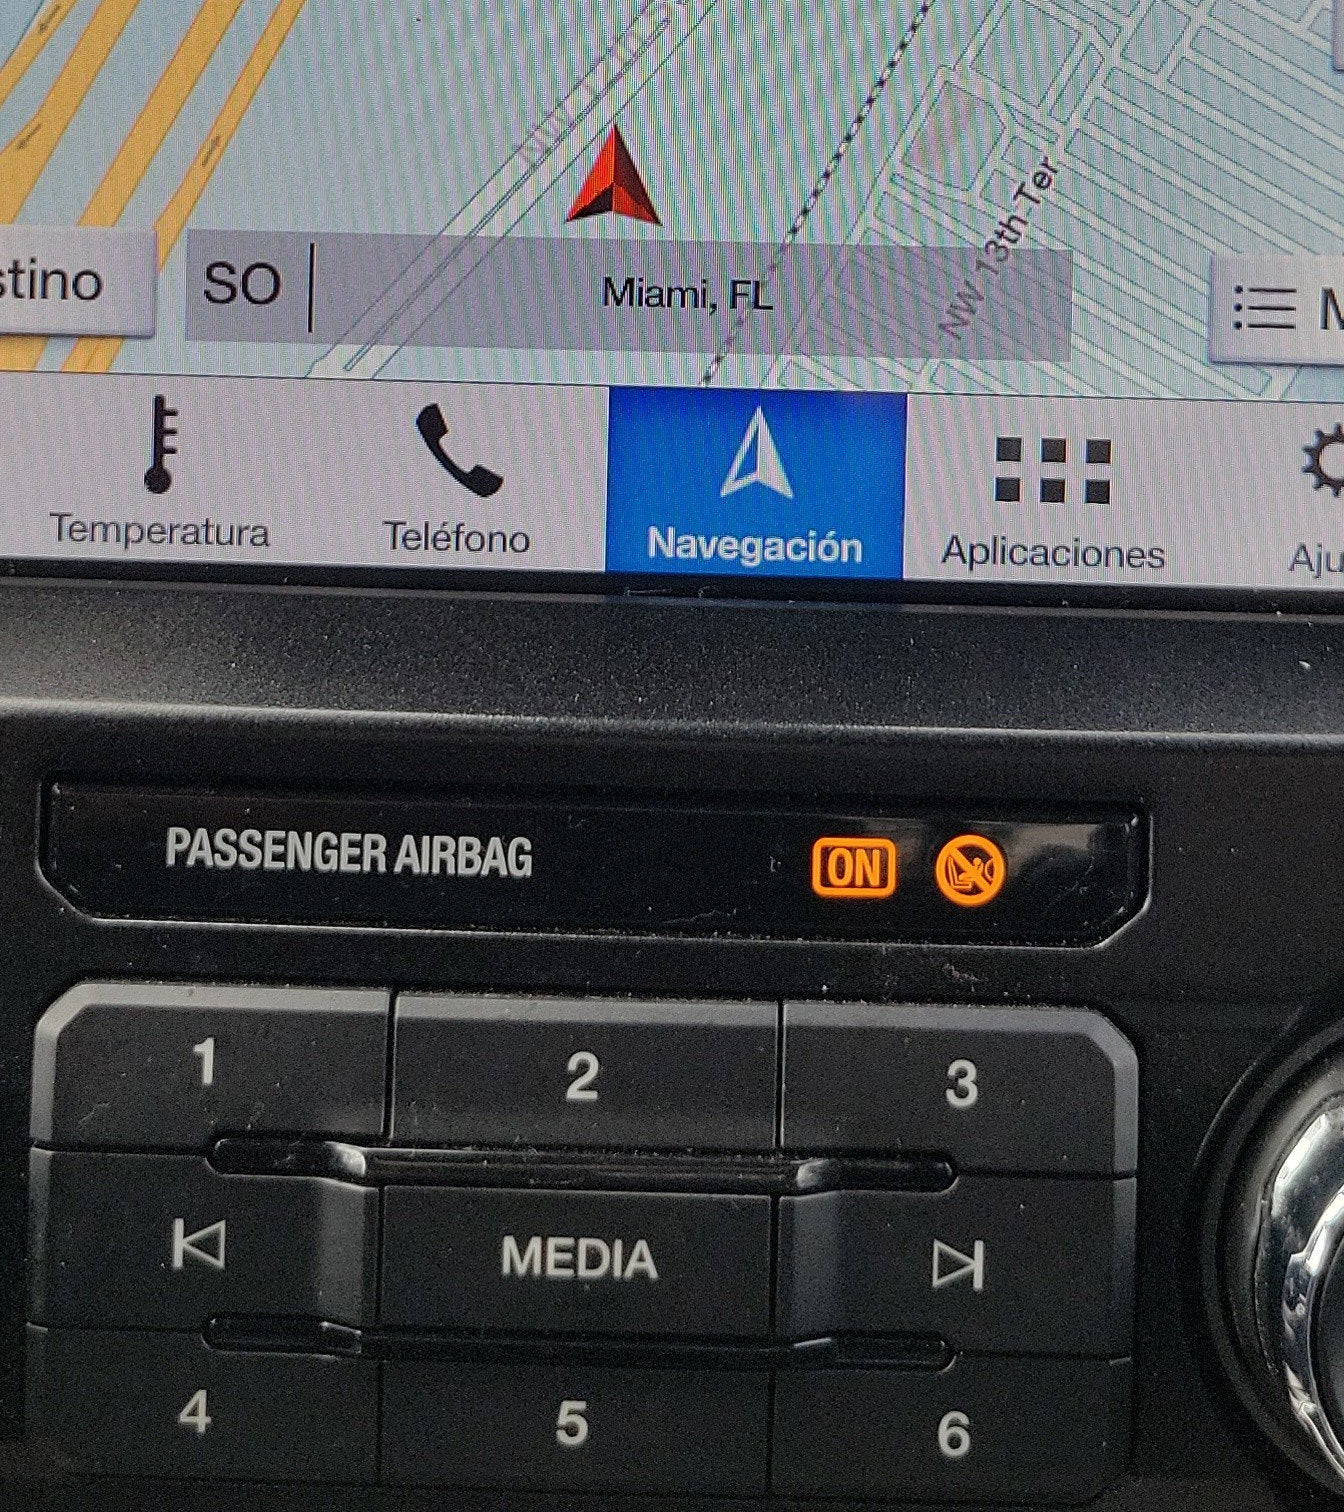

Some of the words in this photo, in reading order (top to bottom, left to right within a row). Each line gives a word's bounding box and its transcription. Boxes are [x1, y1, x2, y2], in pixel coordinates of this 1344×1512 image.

[938, 279, 985, 341] NW
[974, 213, 1030, 275] 13th
[1012, 155, 1059, 205] Ter
[203, 260, 282, 307] SO
[602, 274, 718, 316] Miami,
[728, 278, 774, 311] FL
[49, 510, 271, 550] Temperatura
[382, 518, 531, 555] Teléfono
[647, 524, 864, 567] Navegación
[941, 532, 1166, 575] Aplicaciones
[165, 826, 387, 874] PASSENGER
[393, 833, 533, 878] AIRBAG
[826, 846, 881, 888] ON
[192, 1035, 216, 1085] 1
[565, 1051, 600, 1100] 2
[945, 1059, 979, 1107] 3
[500, 1235, 659, 1282] MEDIA
[178, 1389, 212, 1433] 4
[555, 1401, 589, 1445] 5
[935, 1411, 970, 1457] 6
